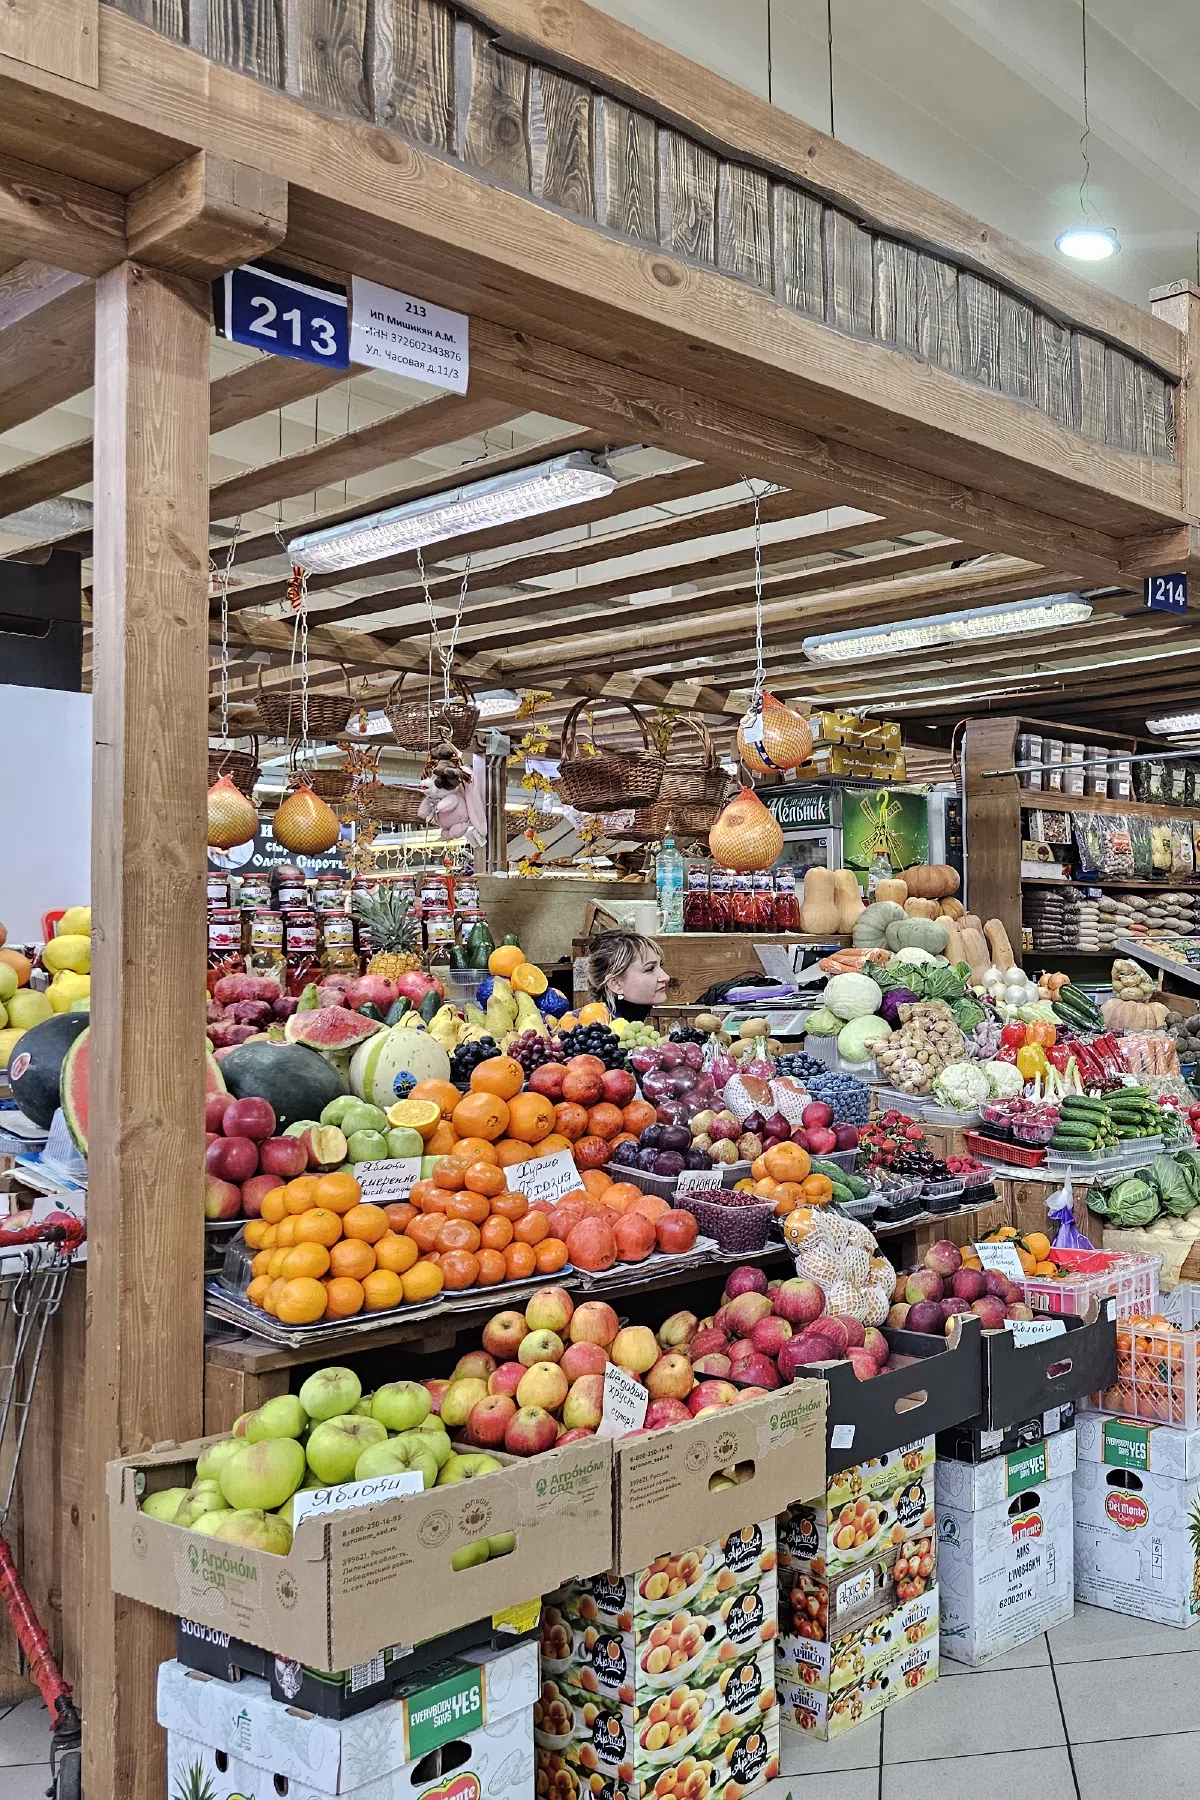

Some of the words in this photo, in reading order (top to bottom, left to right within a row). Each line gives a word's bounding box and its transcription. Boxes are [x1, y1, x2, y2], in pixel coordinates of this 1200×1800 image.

[405, 302, 427, 318] 213
[249, 296, 337, 356] 213
[370, 310, 385, 323] ИП
[387, 314, 433, 336] Мишикян
[435, 330, 456, 344] А.М.
[366, 325, 388, 340] ИНН
[391, 333, 461, 362] 372602343876
[366, 344, 382, 358] Ул.
[385, 350, 425, 370] Часовая
[427, 362, 459, 380] д.11/3
[1156, 578, 1185, 605] 214
[768, 796, 829, 823] Мельник
[784, 796, 818, 807] Старый
[362, 1161, 406, 1172] Яблоки
[517, 1158, 559, 1182] Хурма
[1105, 1436, 1130, 1448] EVERYBODY
[1129, 1441, 1147, 1460] YES
[1030, 1454, 1045, 1475] YES
[312, 1479, 401, 1507] Яблоки
[550, 1481, 575, 1496] сад
[1108, 1500, 1120, 1512] Del
[1121, 1503, 1146, 1518] Monte
[342, 1514, 402, 1537] 8-800-250-16-95
[1020, 1523, 1041, 1538] Monte
[726, 1533, 762, 1563] Apricot
[1154, 1545, 1159, 1553] 6
[342, 1552, 369, 1566] 399621,
[1154, 1556, 1159, 1564] 7
[202, 1567, 226, 1588] сад
[593, 1582, 625, 1598] Apricot
[728, 1605, 762, 1634] Apricot
[900, 1604, 931, 1629] APRICOT
[949, 1612, 960, 1621] AIR
[181, 1618, 230, 1648] AVOCADOS
[593, 1656, 625, 1673] Apricot
[791, 1647, 827, 1667] APRICOT
[900, 1650, 931, 1673] APRICOT
[726, 1674, 760, 1706] Apricot
[411, 1698, 452, 1727] EVERYBODY
[452, 1685, 480, 1719] YES
[789, 1692, 823, 1713] APRICOT
[433, 1711, 452, 1728] SAYS
[593, 1732, 625, 1749] Apricot
[732, 1742, 766, 1776] Apricot
